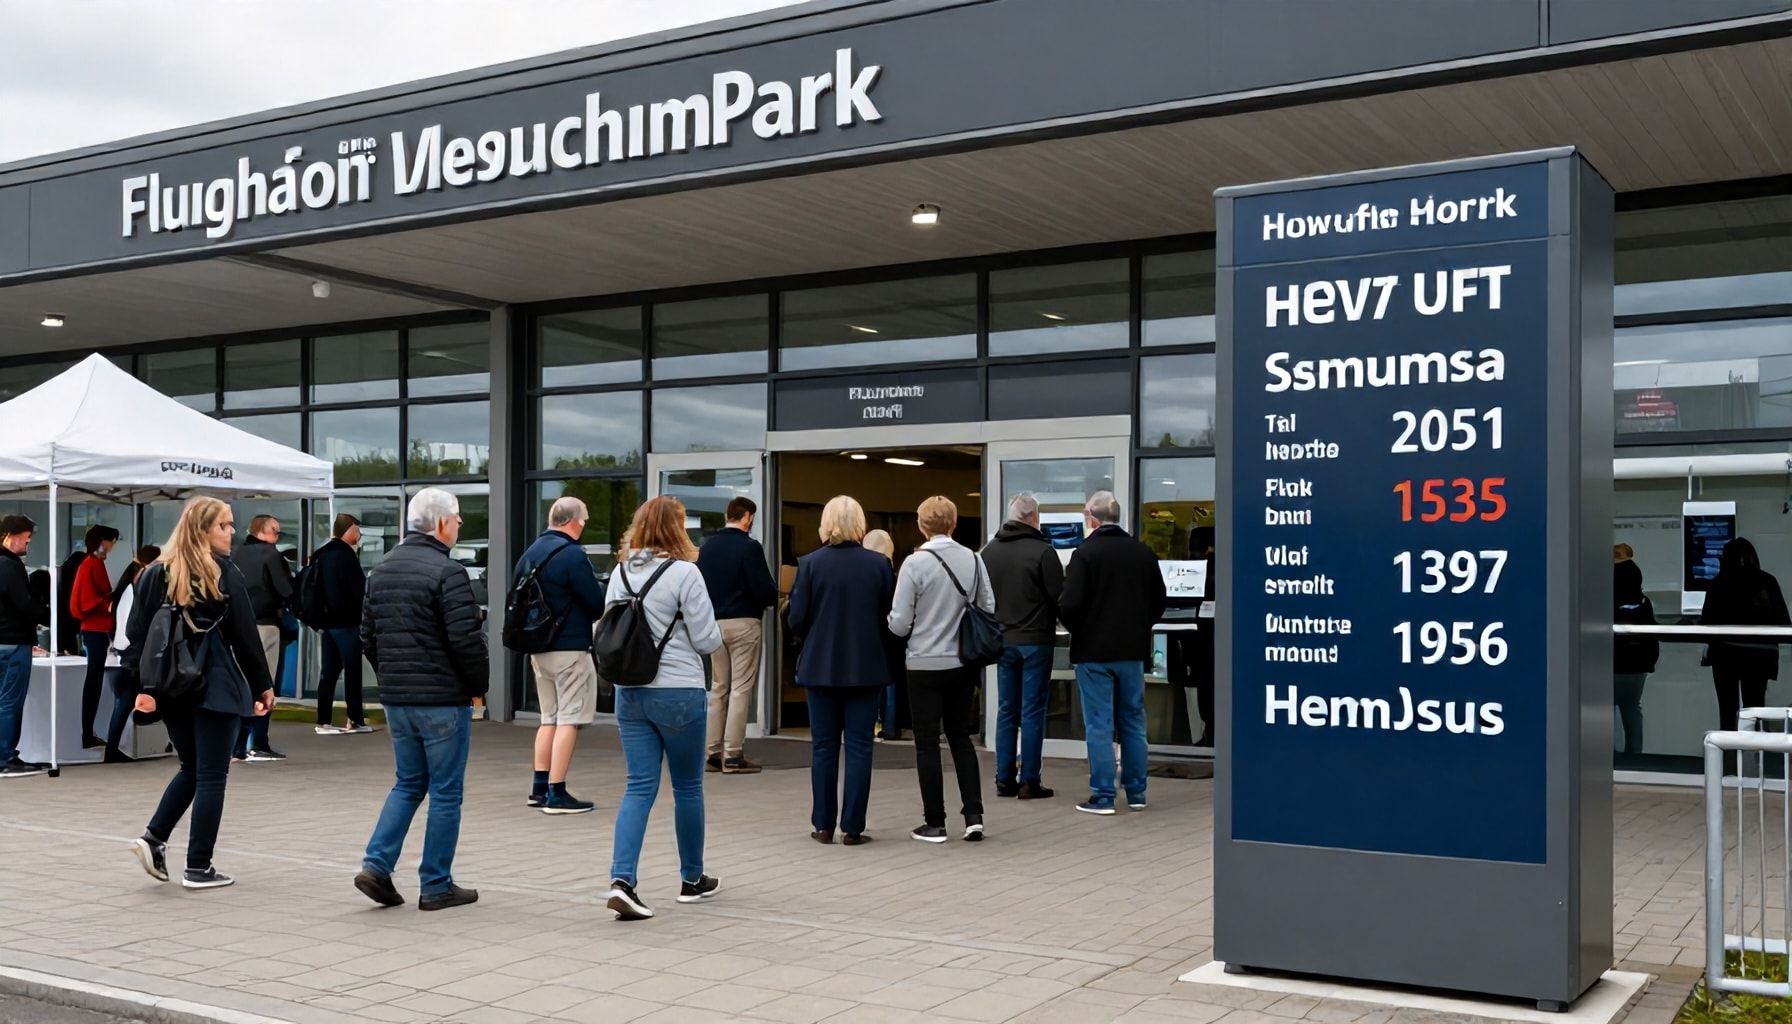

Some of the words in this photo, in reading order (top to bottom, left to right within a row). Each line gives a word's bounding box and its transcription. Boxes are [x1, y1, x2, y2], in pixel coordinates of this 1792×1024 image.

[1413, 264, 1512, 316] UFT
[1264, 348, 1505, 393] Ssmumsa
[1390, 406, 1502, 454] 2051
[1393, 477, 1507, 523] 1535
[1393, 549, 1508, 594] 1397
[1392, 620, 1508, 666] 1956
